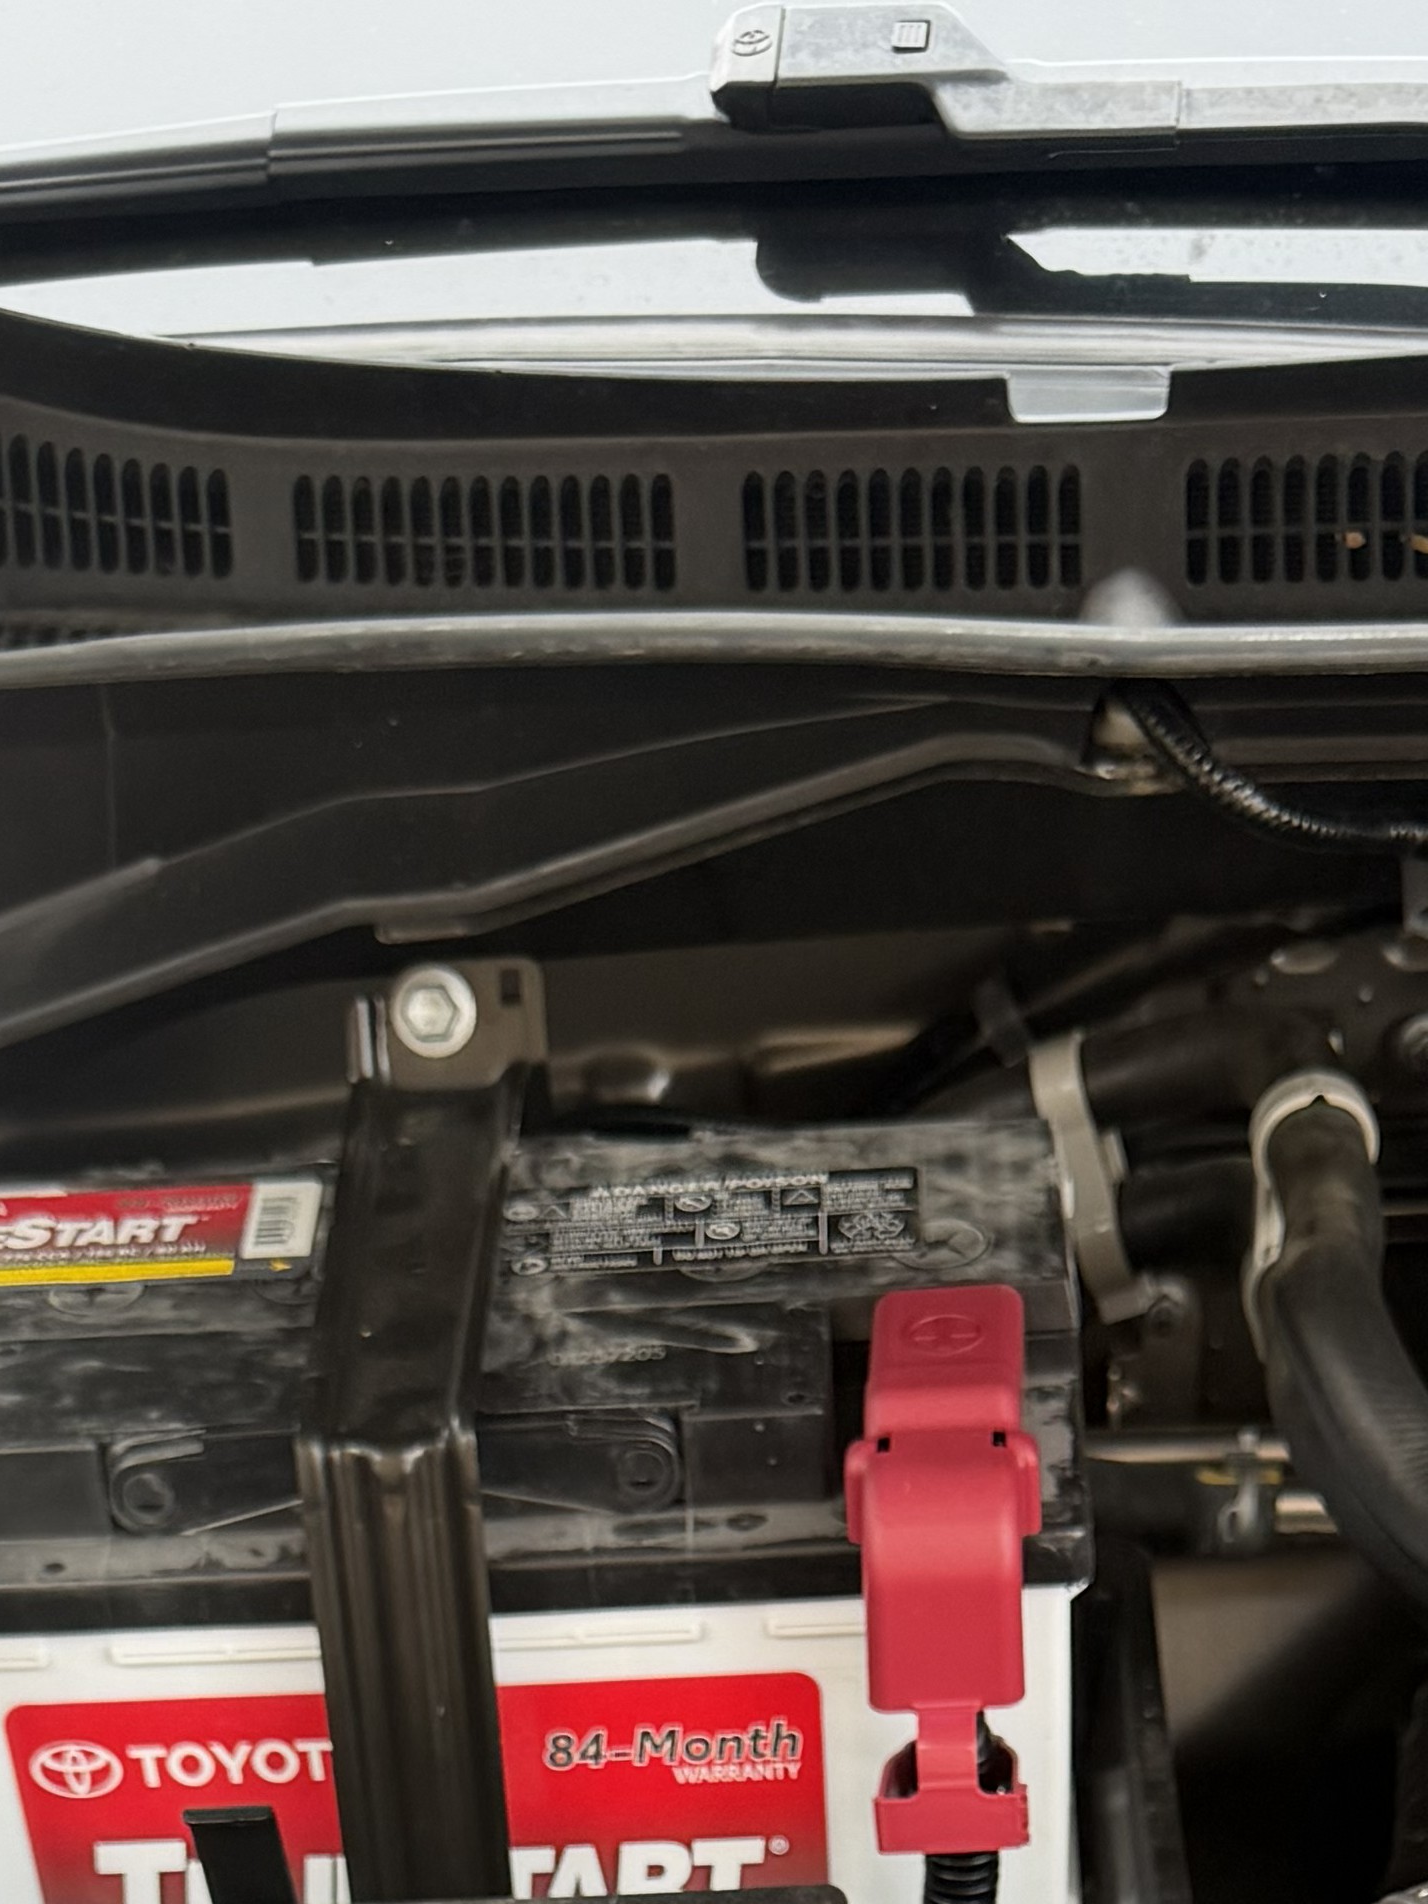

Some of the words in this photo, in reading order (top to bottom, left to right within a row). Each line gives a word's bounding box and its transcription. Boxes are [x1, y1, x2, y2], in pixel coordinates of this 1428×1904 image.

[128, 1738, 333, 1789] TOYOT
[546, 1717, 804, 1770] 84-Month
[672, 1762, 801, 1785] WARRANTY
